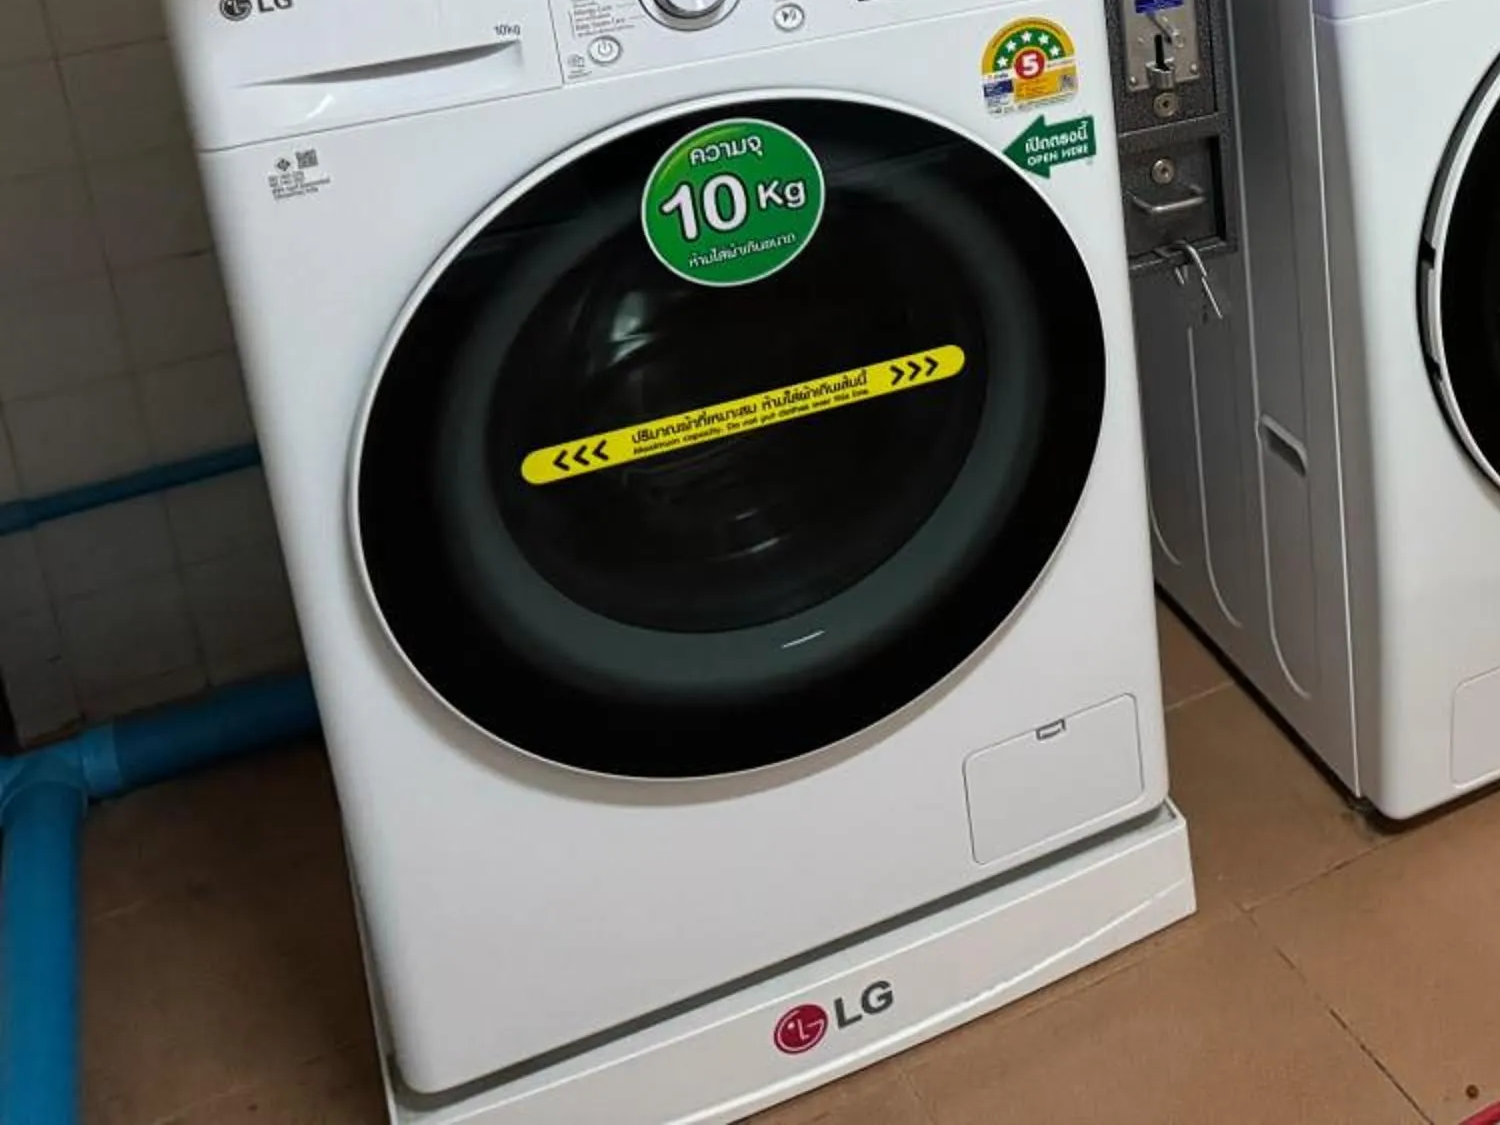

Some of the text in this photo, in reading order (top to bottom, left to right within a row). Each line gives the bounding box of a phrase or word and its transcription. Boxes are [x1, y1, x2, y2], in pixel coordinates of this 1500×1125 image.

[1021, 53, 1040, 77] 5
[690, 135, 764, 166] ความจุ
[1027, 149, 1059, 167] OPEN
[661, 174, 806, 240] 10 Kg
[833, 980, 894, 1031] LG
